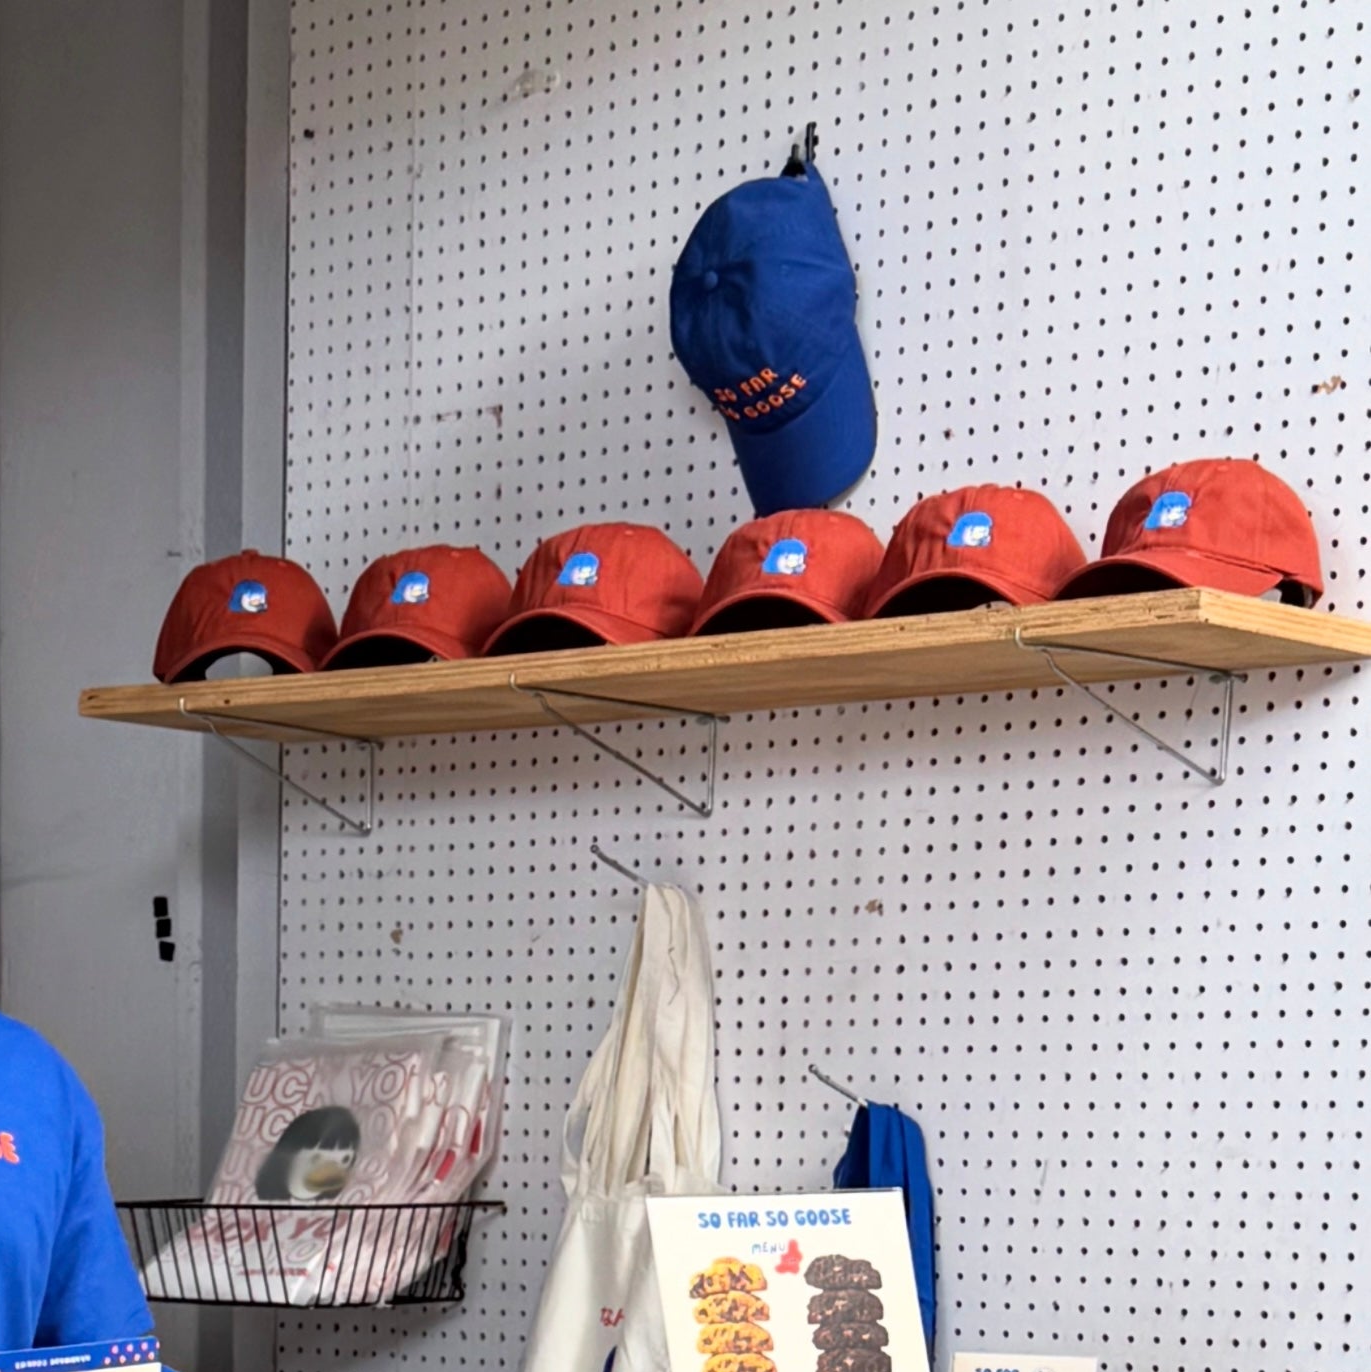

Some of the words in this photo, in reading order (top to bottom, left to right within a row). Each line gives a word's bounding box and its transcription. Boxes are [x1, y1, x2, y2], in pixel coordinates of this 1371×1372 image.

[740, 368, 779, 396] FAR
[743, 373, 807, 418] GOOSE
[697, 1212, 722, 1229] SO
[727, 1211, 761, 1228] FAR
[765, 1210, 789, 1227] SO
[794, 1208, 853, 1226] GOOSE
[751, 1242, 787, 1255] MENU
